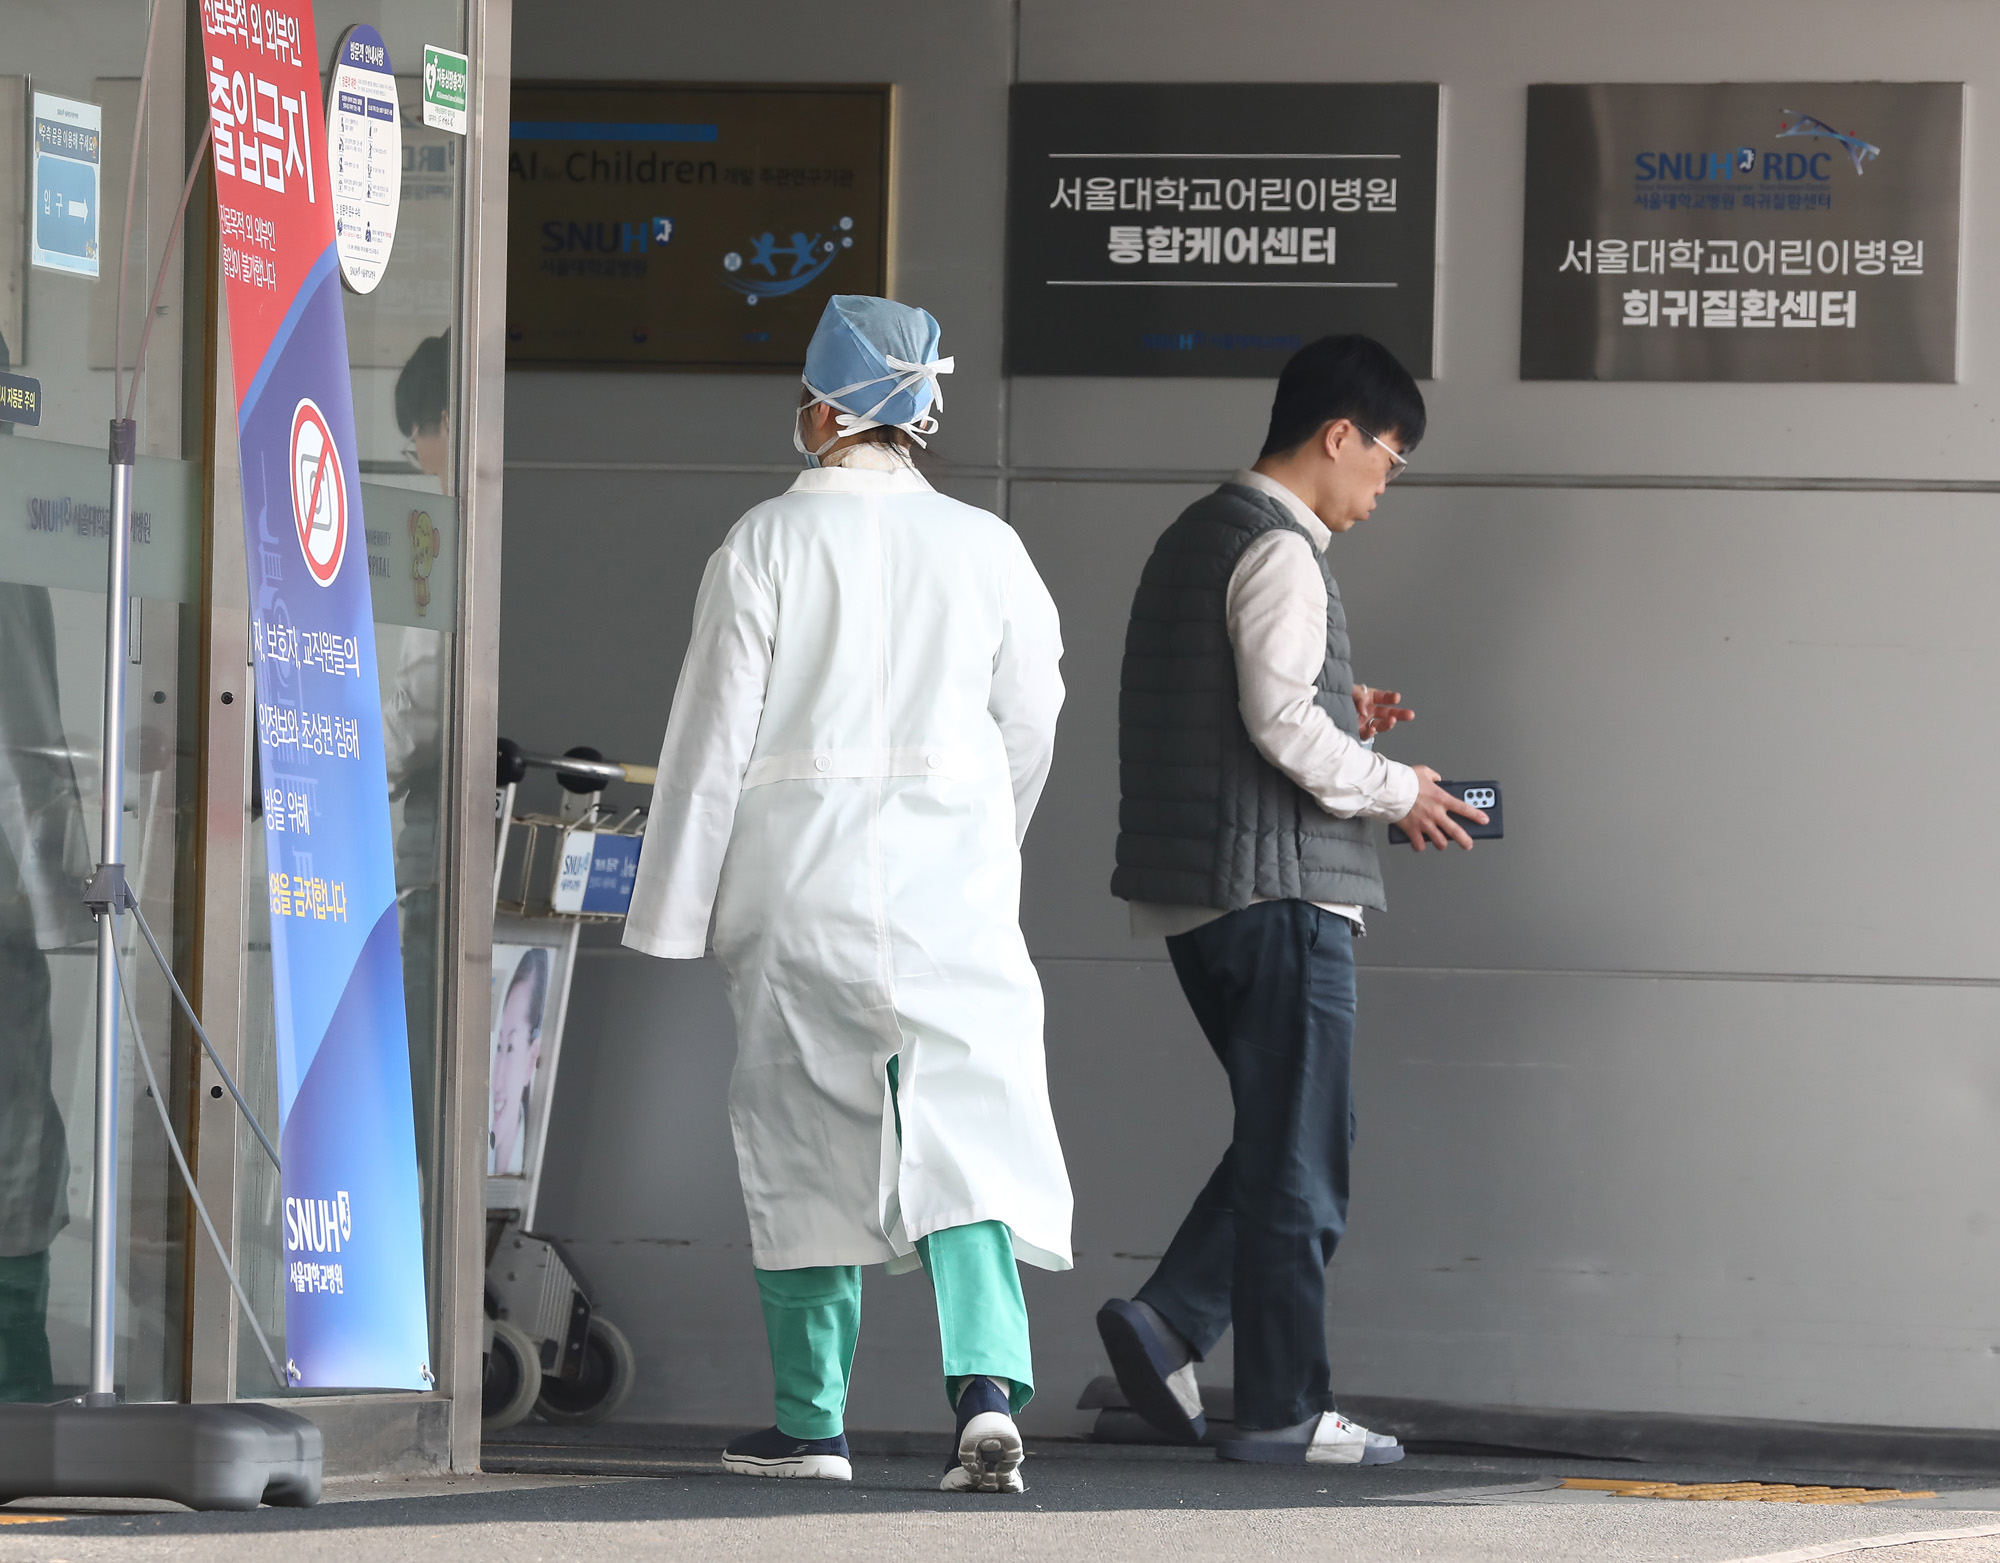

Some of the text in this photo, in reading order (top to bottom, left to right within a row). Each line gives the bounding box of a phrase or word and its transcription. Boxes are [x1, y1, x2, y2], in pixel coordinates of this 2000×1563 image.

[203, 0, 303, 68] 진료목적 외 외부인
[349, 41, 385, 67] 방문객 안내사항
[436, 66, 466, 93] 자동심장충격기
[41, 124, 52, 144] 우측
[52, 127, 63, 146] 문을
[63, 129, 78, 150] 이용해
[209, 55, 316, 204] 출입금지
[508, 150, 538, 183] AI
[564, 150, 718, 186] Children
[1634, 152, 1833, 182] SNUH RDC
[1049, 175, 1399, 213] 서울대학교어린이병원
[219, 204, 277, 253] 진료목적 외 외부인
[541, 220, 649, 254] SNUH
[1107, 225, 1338, 266] 통합케어센터
[241, 251, 277, 293] 불가합니다
[1558, 238, 1925, 276] 서울대학교어린이병원
[1622, 288, 1858, 329] 희귀질환센터
[7, 387, 24, 409] 자동문
[24, 390, 37, 412] 주의
[30, 496, 64, 533] SNUH
[266, 622, 302, 671] 보호자,
[302, 630, 361, 679] 교직원들의
[258, 703, 361, 762] 인정보와 초상권 침해
[263, 787, 311, 836] 방을 위해
[268, 870, 348, 924] 영을 금지합니다
[285, 1196, 342, 1254] SNUH
[289, 1260, 345, 1295] 서울대학교병원
